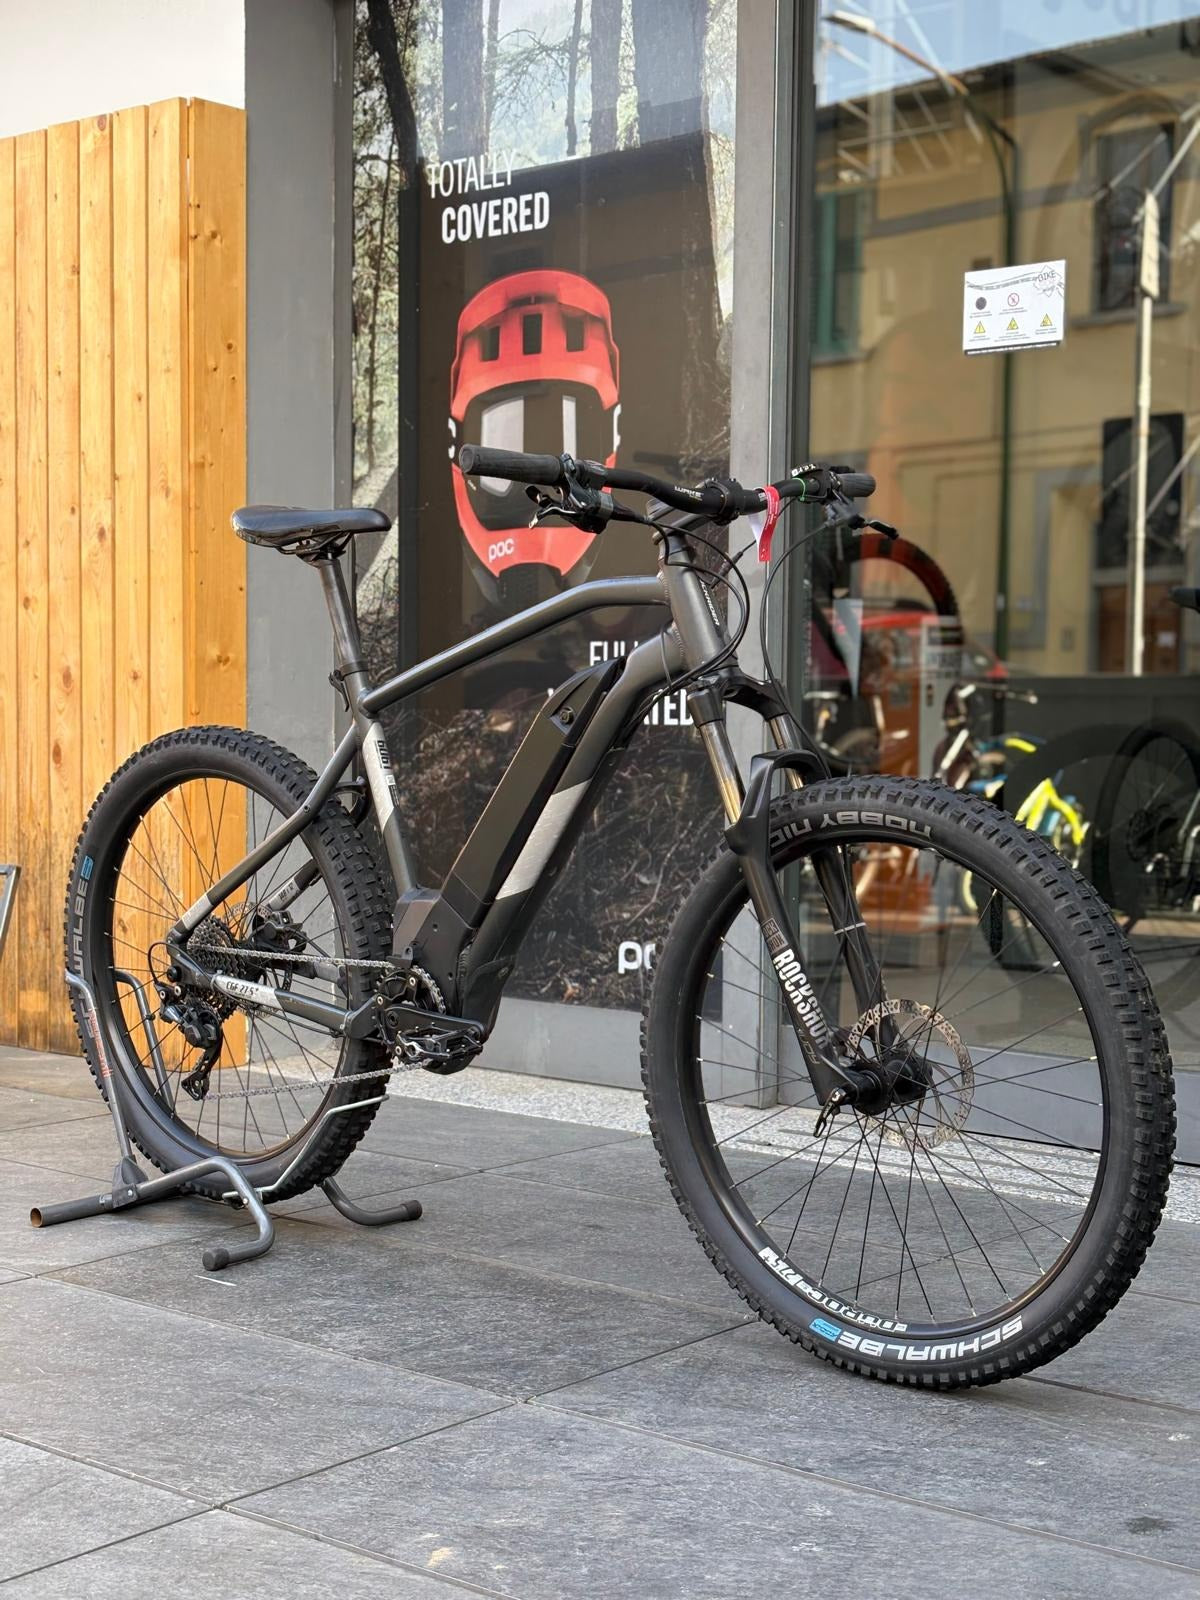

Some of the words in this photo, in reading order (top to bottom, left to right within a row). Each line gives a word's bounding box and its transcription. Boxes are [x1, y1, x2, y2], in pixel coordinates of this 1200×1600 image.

[427, 152, 517, 199] TOTALLY
[440, 190, 550, 245] COVERED
[488, 538, 515, 562] poc
[769, 818, 812, 848] NIC
[819, 810, 932, 840] NOBBY
[837, 1314, 1024, 1361] SCHWALBE
